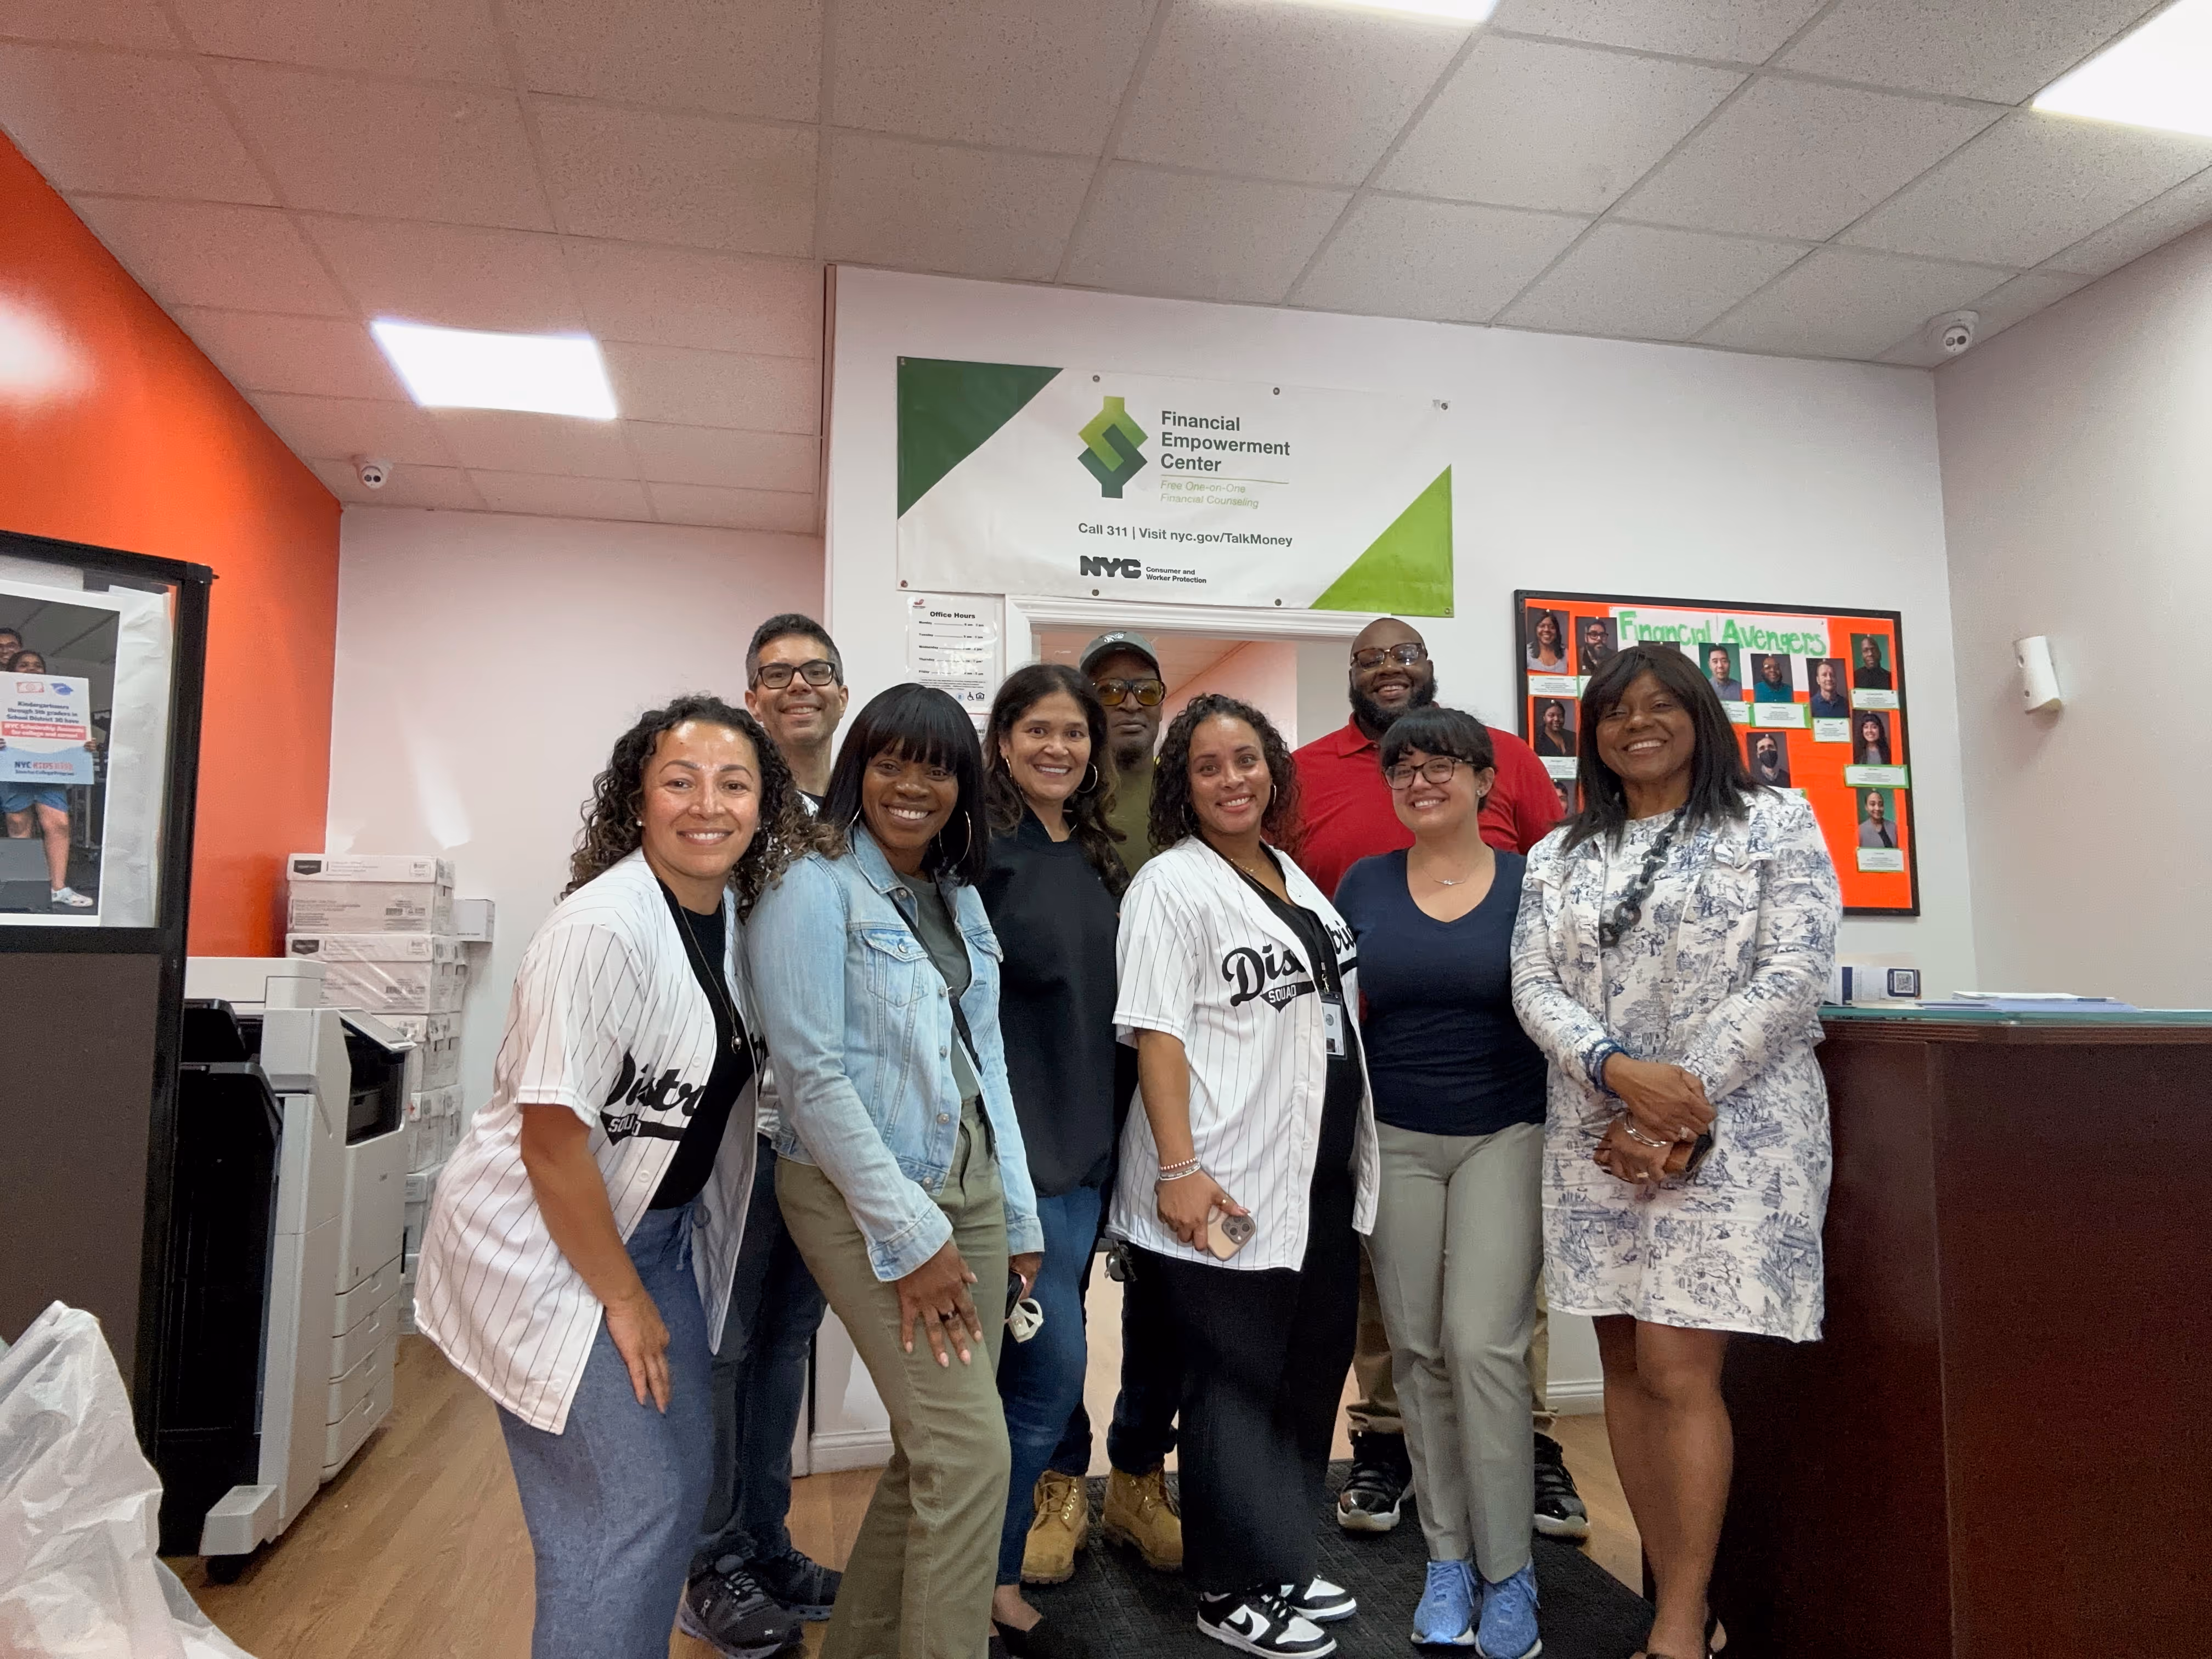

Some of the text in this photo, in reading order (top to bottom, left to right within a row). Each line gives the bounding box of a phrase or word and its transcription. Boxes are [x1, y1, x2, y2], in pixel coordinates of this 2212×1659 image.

[1161, 410, 1240, 432] Financial
[1161, 431, 1290, 456] Empowerment
[1160, 453, 1222, 472] Center
[1160, 480, 1246, 494] Free One-on-One
[1160, 493, 1259, 510] Financial Counseling
[1078, 522, 1103, 535] Call
[1107, 525, 1127, 537] 311
[1139, 527, 1167, 540] Visit
[1170, 532, 1293, 548] nyc.gov/TalkMoney
[1080, 555, 1142, 579] NYC
[1146, 566, 1181, 575] Consumer
[1146, 574, 1207, 584] Worker Protection
[1618, 610, 1827, 657] Financial Avengers
[1268, 984, 1297, 1003] SQUAD
[608, 1115, 642, 1136] SQUD
